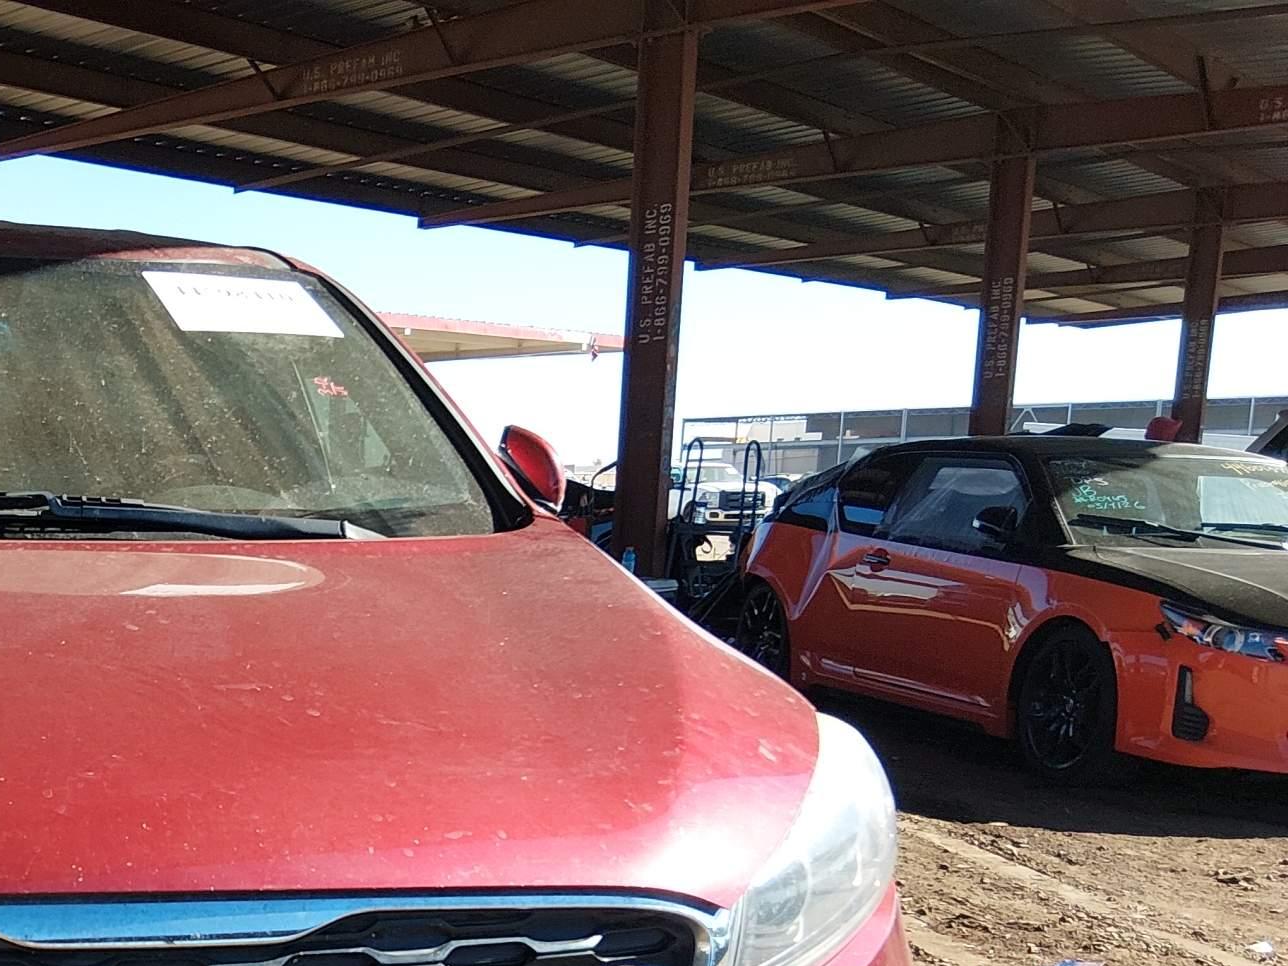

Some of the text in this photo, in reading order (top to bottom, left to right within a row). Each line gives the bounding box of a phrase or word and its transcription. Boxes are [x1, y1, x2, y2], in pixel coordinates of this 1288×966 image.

[639, 203, 658, 344] U.S. PREFAB INC.
[653, 203, 672, 341] 1-866-799-0969
